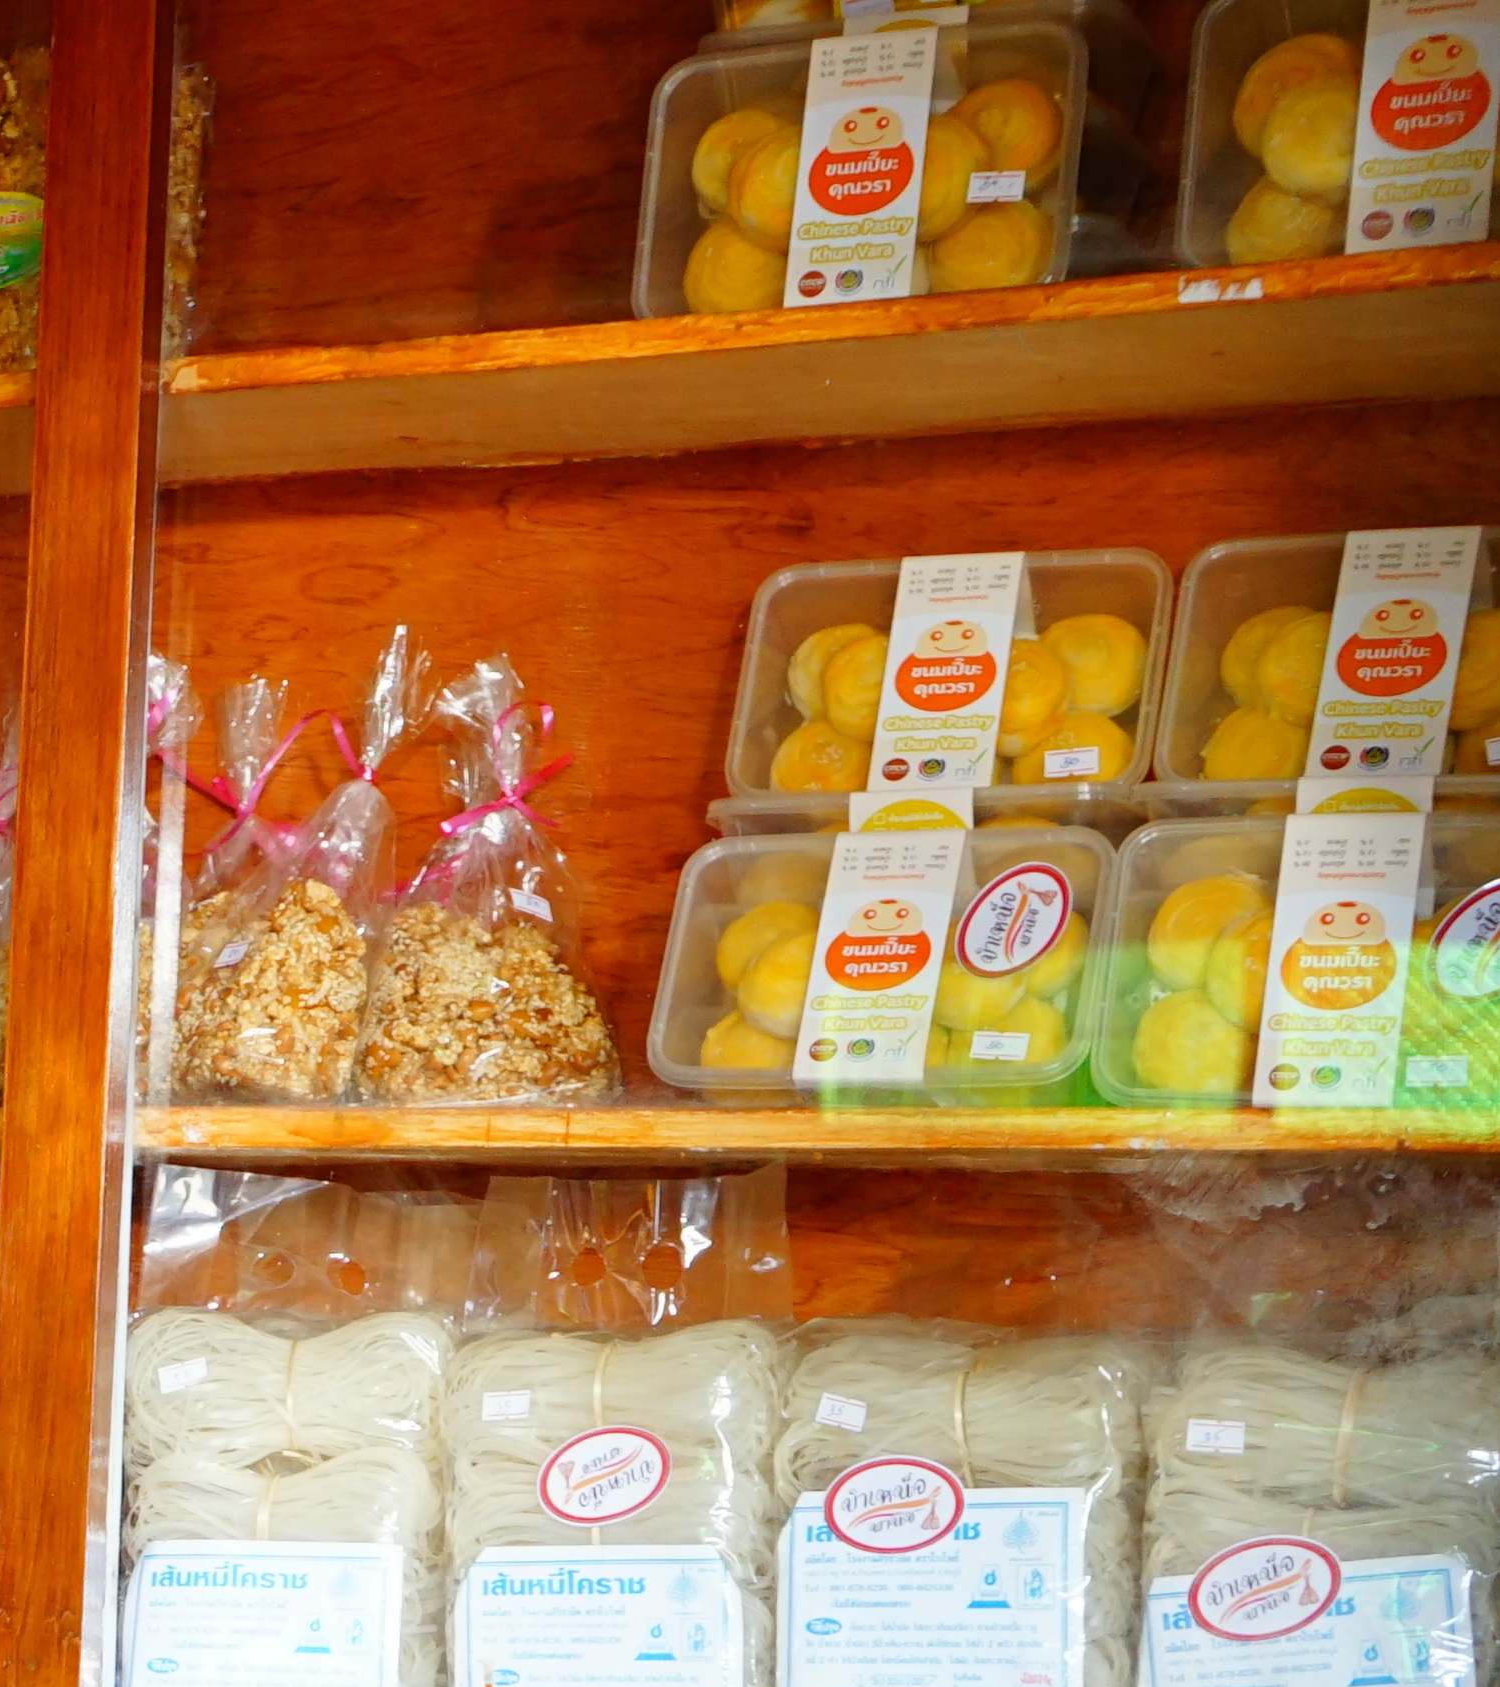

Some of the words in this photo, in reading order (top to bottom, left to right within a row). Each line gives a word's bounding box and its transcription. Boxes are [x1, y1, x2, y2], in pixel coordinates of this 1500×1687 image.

[828, 179, 892, 201] คุณวรา
[1356, 665, 1423, 682] คุณวรา
[913, 682, 976, 698] คุณวรา
[883, 716, 942, 732] Chinese
[945, 714, 996, 731] Pastry
[895, 737, 937, 752] Khun
[940, 736, 977, 751] Vara
[844, 960, 908, 979] คุณวรา
[1303, 975, 1374, 992] คุณวรา
[811, 995, 873, 1013] Chinese
[875, 994, 929, 1012] Pastry
[821, 1016, 866, 1031] Khun
[867, 1015, 908, 1030] Vara
[1268, 1013, 1339, 1032] Chinese
[1341, 1014, 1398, 1033] Pastry
[1282, 1039, 1332, 1058] Khun
[1333, 1039, 1378, 1058] Vara
[150, 1561, 309, 1591] เส้นหมี่โคราช
[481, 1567, 647, 1596] เส้นหมี่โคราช
